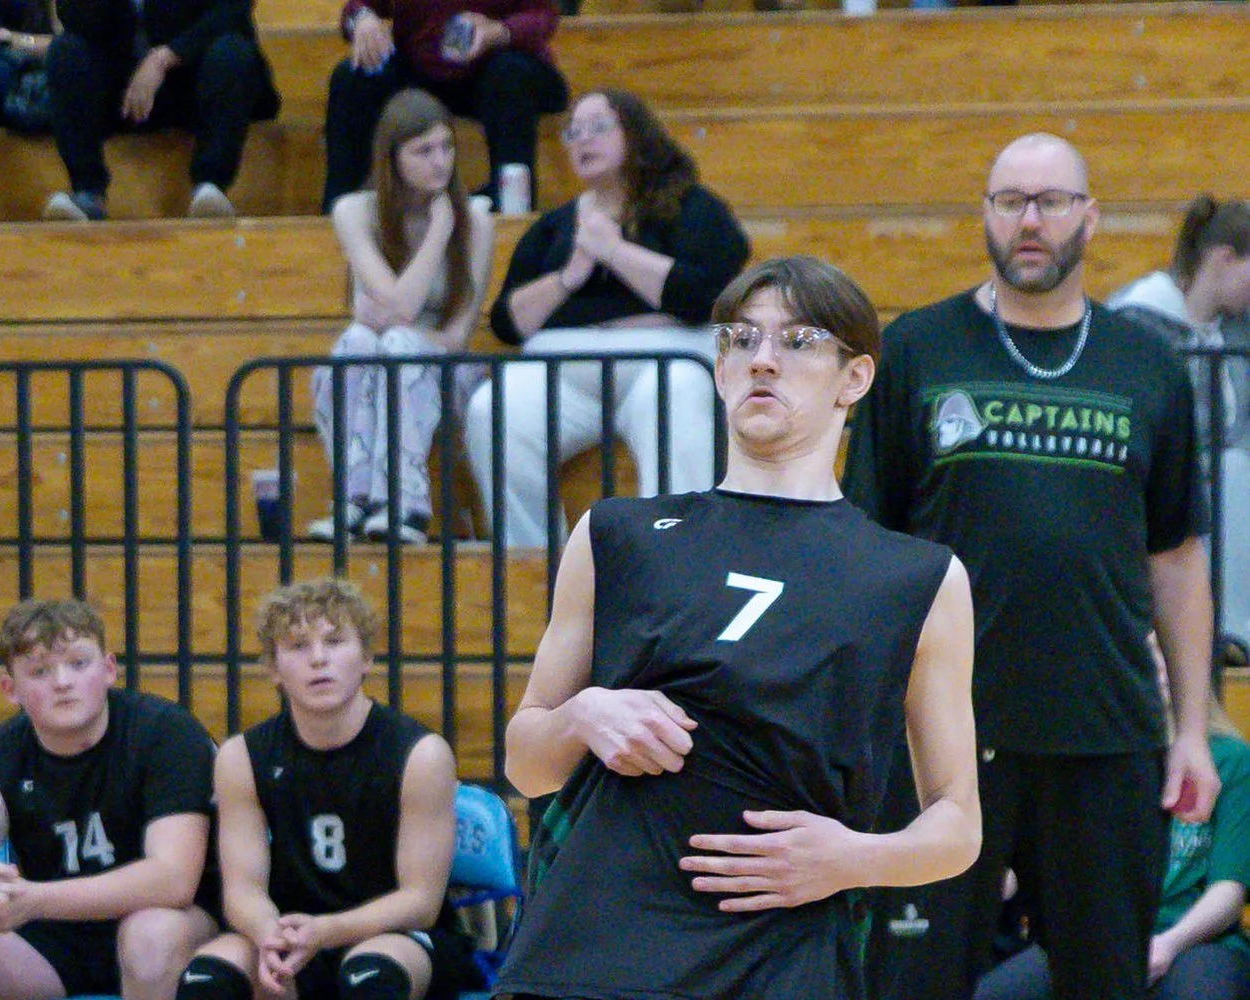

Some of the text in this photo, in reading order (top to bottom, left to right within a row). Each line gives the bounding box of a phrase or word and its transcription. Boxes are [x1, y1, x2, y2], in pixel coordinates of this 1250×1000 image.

[984, 400, 1131, 440] CAPTAINS
[716, 571, 786, 641] 7
[53, 810, 116, 875] 14
[311, 813, 348, 873] 8
